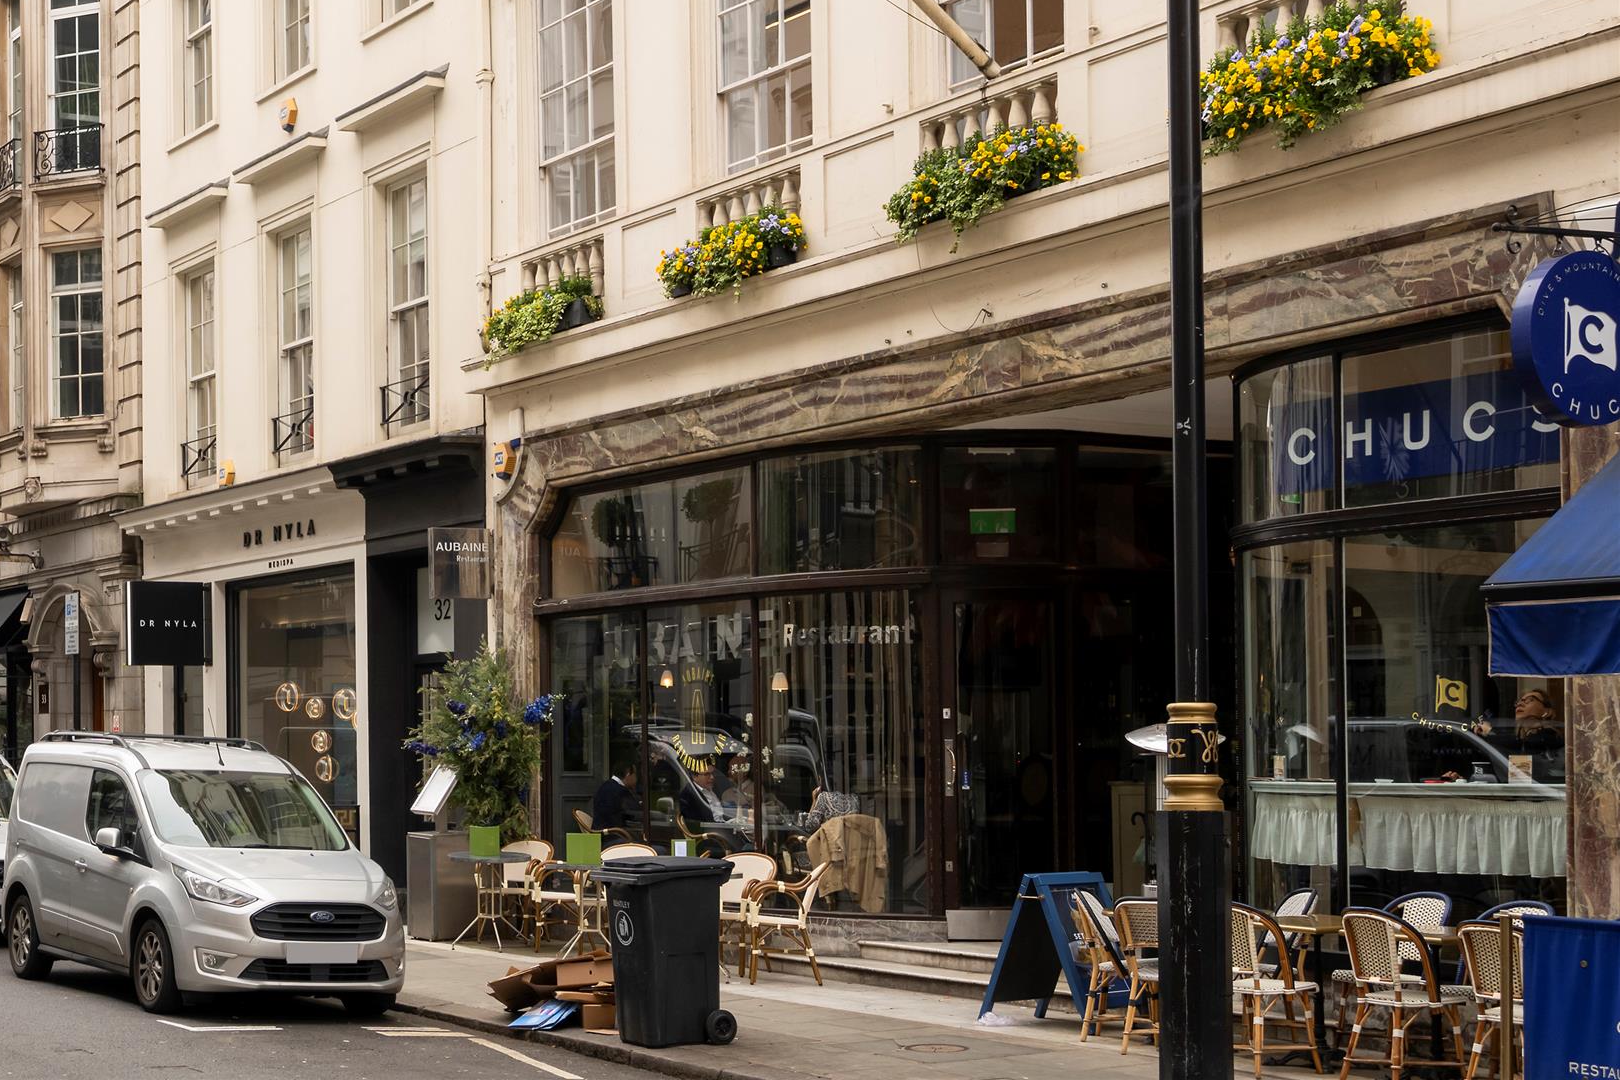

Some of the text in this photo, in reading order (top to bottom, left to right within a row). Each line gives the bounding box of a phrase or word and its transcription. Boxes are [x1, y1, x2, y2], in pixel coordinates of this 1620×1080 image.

[243, 519, 316, 548] DR NYLA
[435, 542, 489, 552] AUBAINE
[434, 598, 451, 621] 32
[139, 619, 197, 628] DR NYLA
[1411, 711, 1453, 732] CHUCS
[714, 733, 727, 756] BAR
